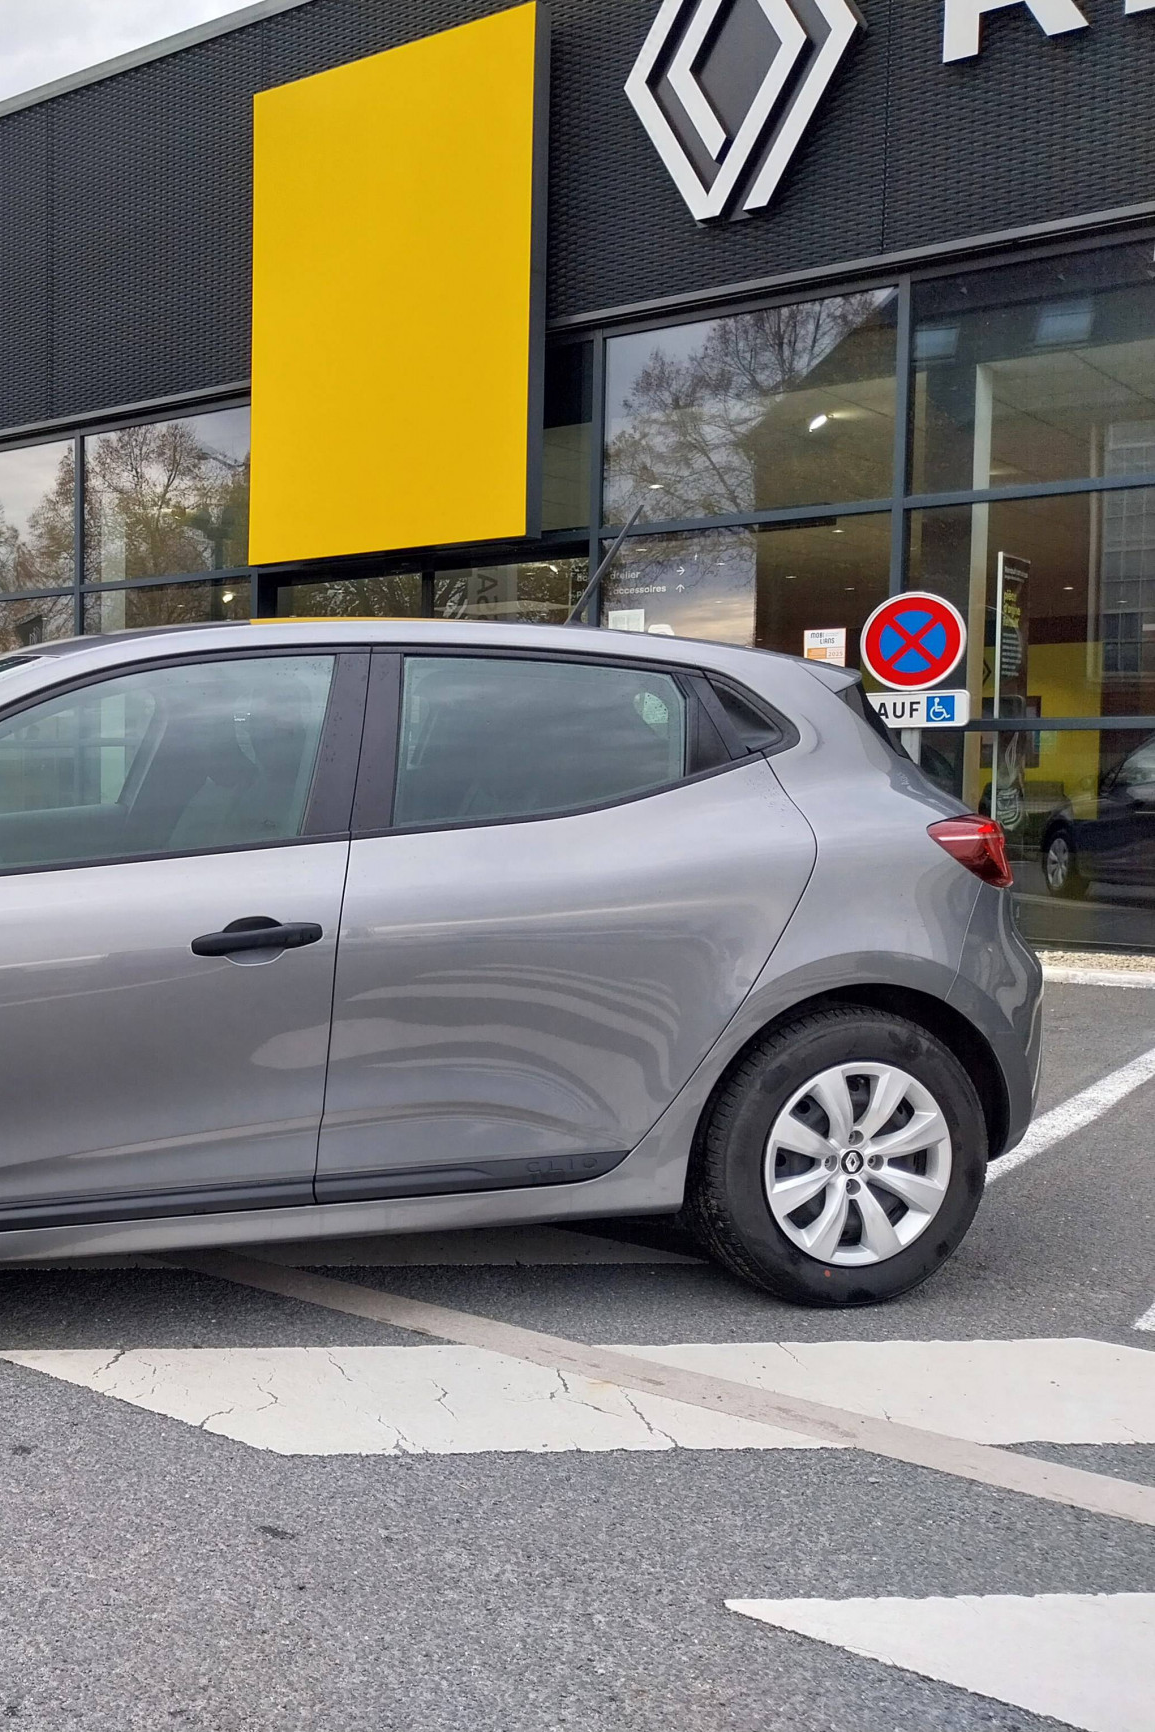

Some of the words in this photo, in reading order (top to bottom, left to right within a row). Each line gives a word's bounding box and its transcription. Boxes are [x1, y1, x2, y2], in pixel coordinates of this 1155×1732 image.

[613, 584, 667, 595] accessoires
[877, 701, 921, 719] AUF
[526, 1157, 598, 1173] CLIO
